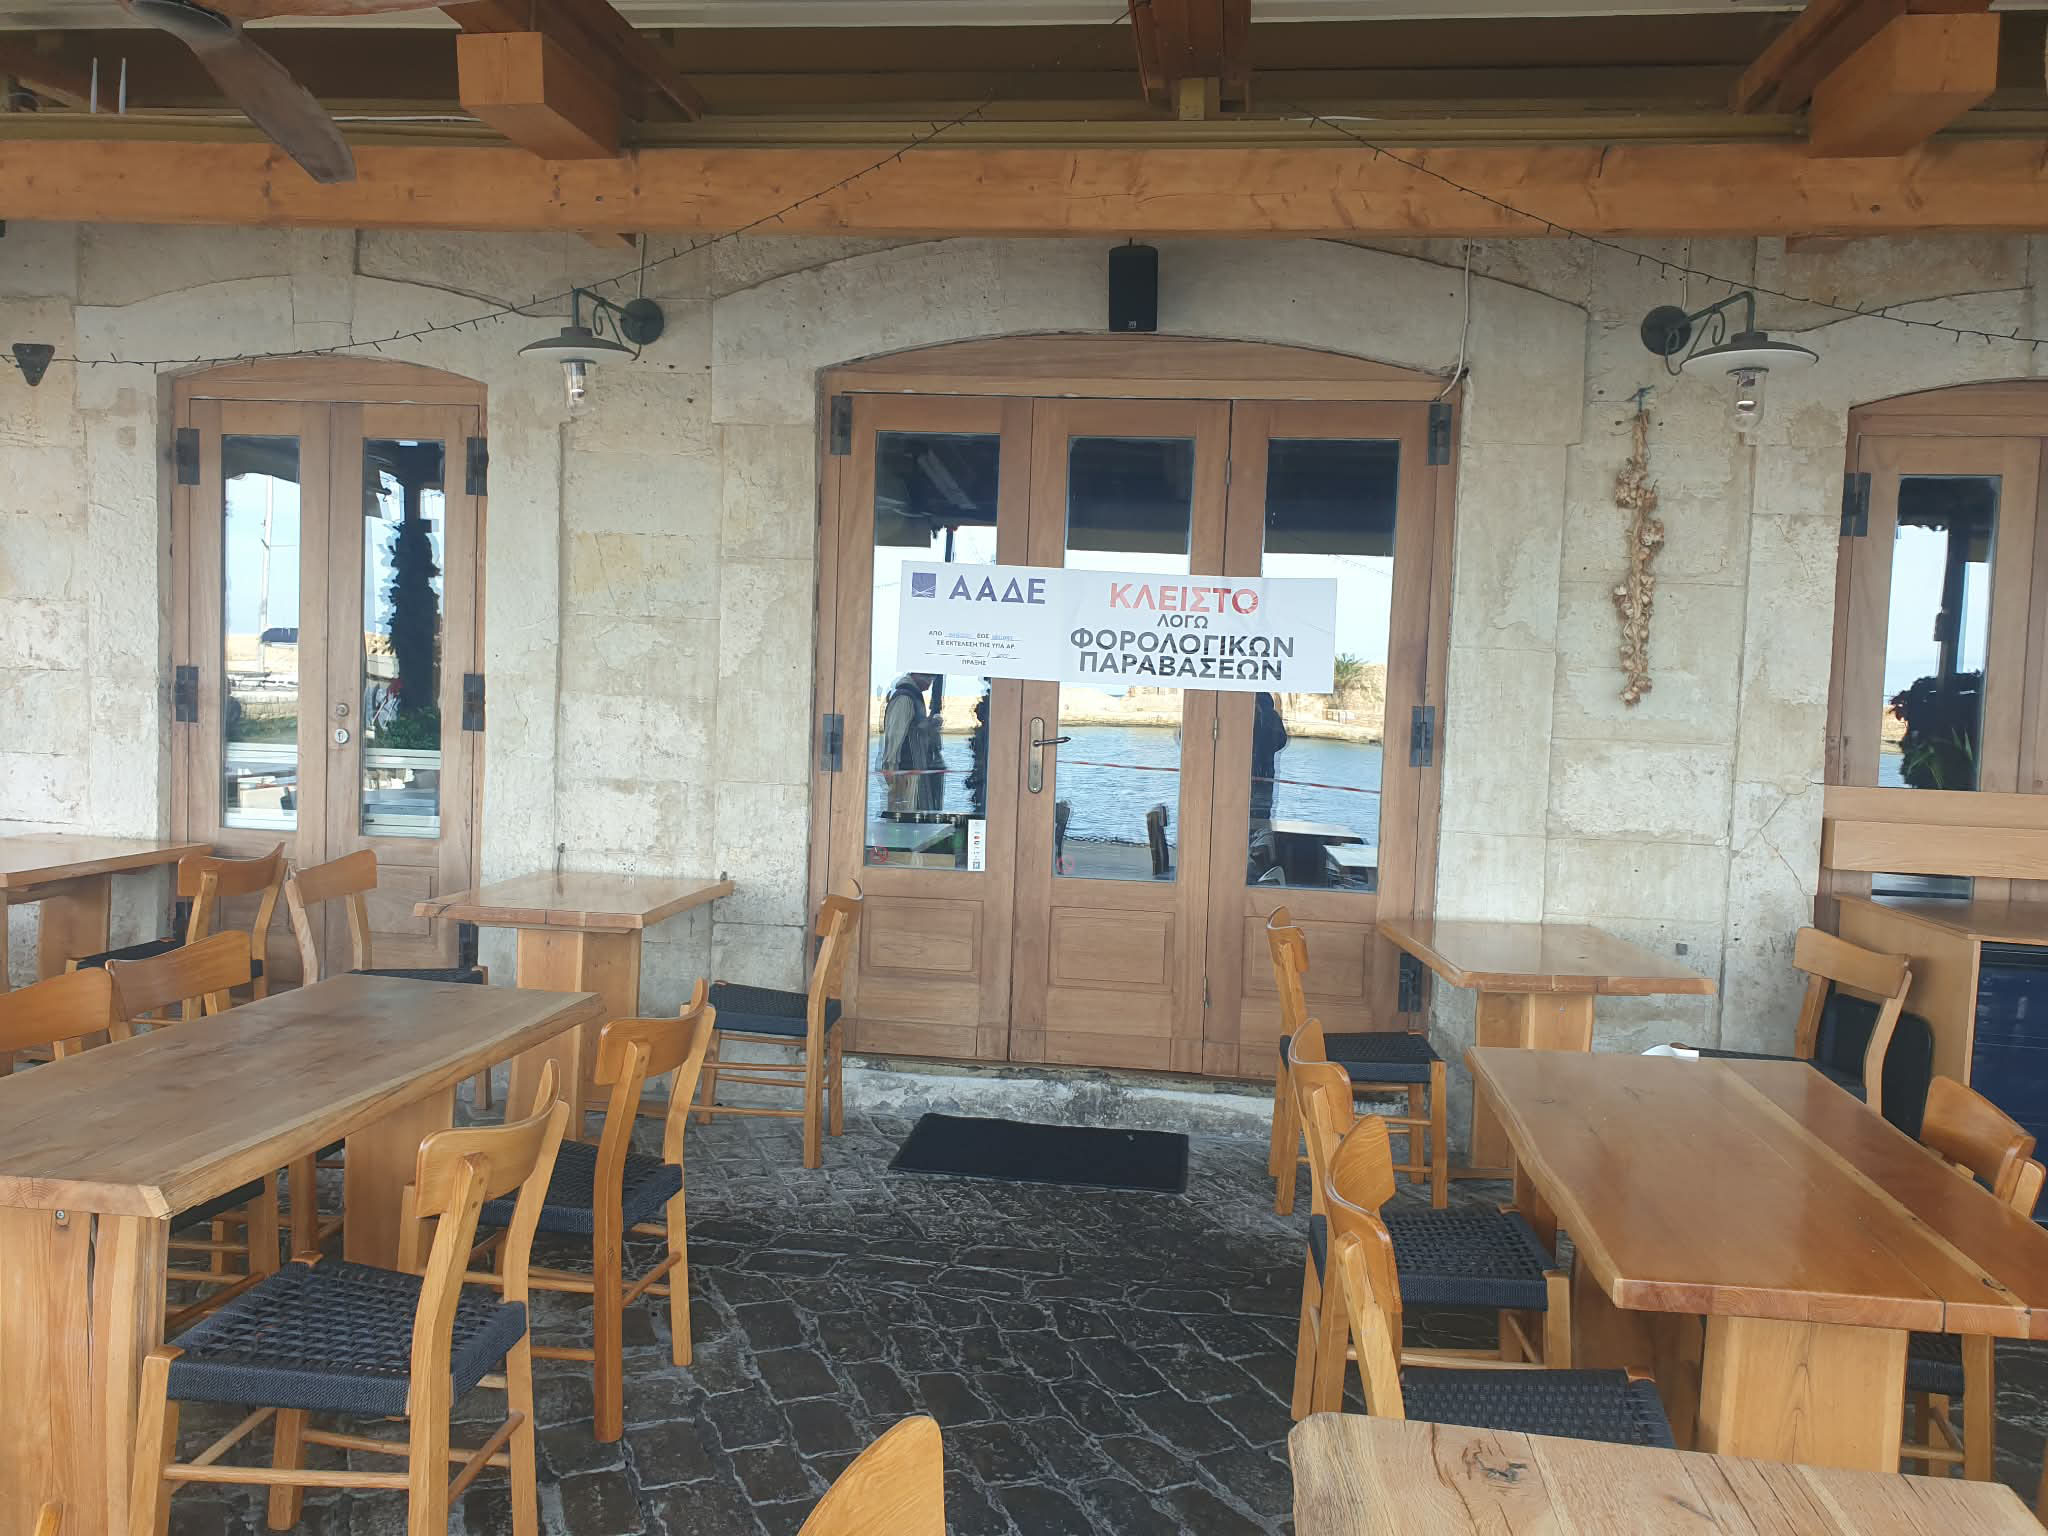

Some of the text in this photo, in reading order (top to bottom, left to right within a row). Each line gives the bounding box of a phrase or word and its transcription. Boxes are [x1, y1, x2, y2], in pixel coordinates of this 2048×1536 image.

[949, 574, 1046, 605] ΑΑΔΕ
[1110, 582, 1259, 615] ΚΛΕΙΣΤΟ
[1157, 614, 1209, 630] ΛΟΓΩ
[1070, 627, 1295, 658] ΦΟΡΟΛΟΓΙΚΩΝ
[1079, 651, 1283, 681] ΠΑΡΑΒΑΣΕΩΝ
